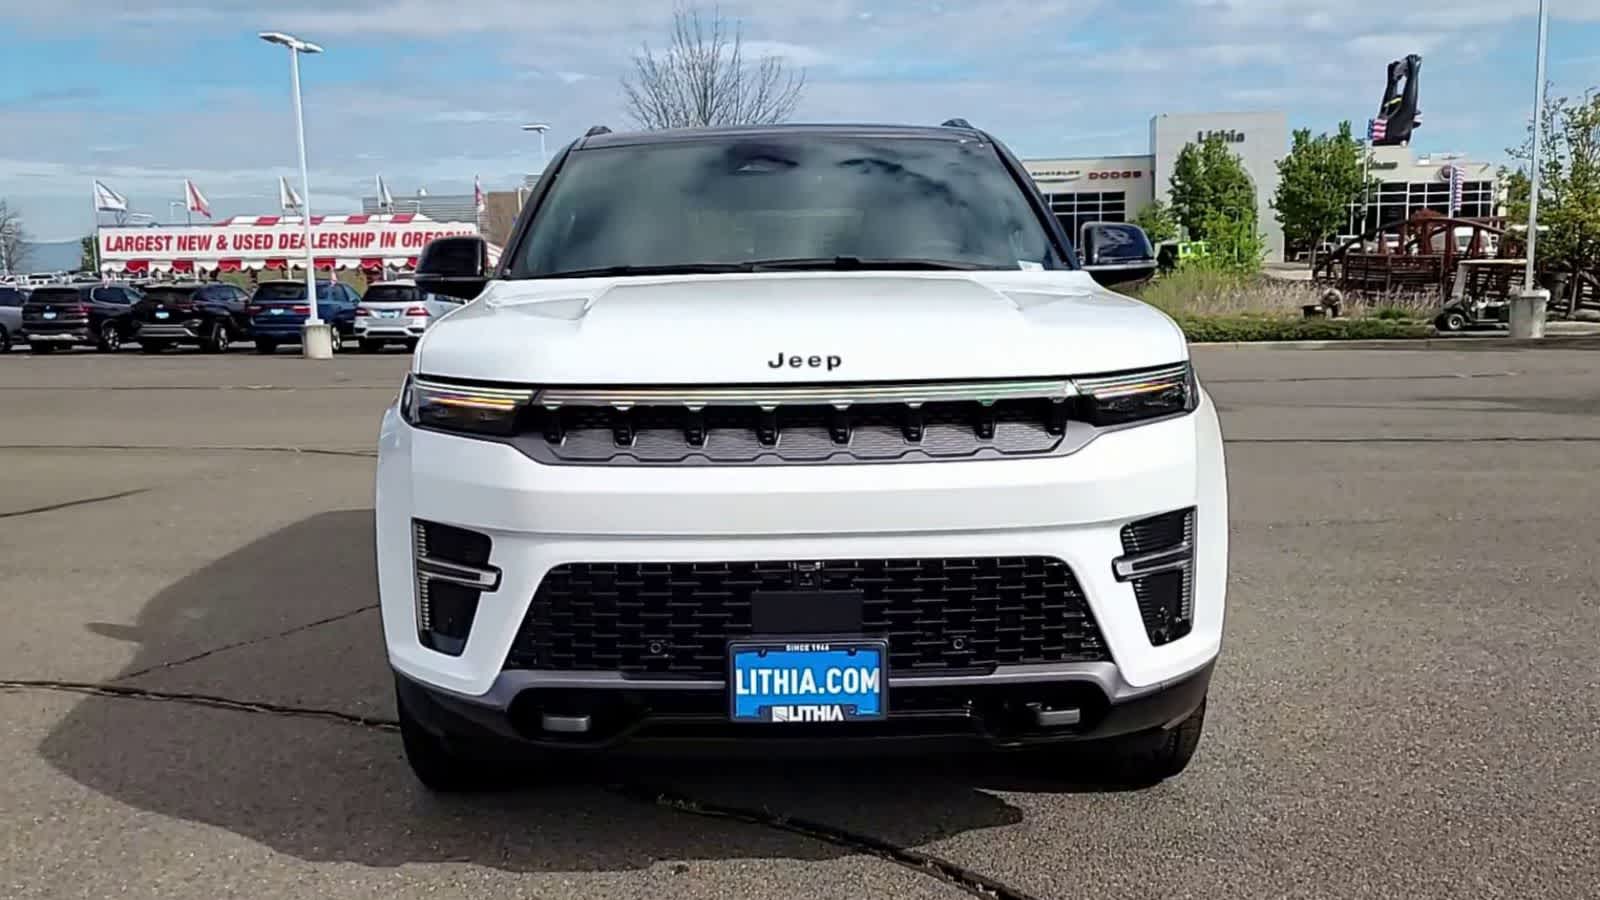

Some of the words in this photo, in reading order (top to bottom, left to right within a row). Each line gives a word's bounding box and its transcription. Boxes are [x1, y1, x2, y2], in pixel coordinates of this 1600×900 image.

[1088, 171, 1142, 180] DODGE
[105, 235, 172, 252] LARGEST
[176, 235, 212, 252] NEW
[216, 235, 228, 251] &
[232, 234, 273, 251] USED
[278, 232, 375, 249] DEALERSHIP
[380, 231, 397, 248] IN
[401, 230, 472, 248] ORE
[767, 352, 842, 371] Jeep
[786, 643, 809, 652] SINCE
[735, 667, 880, 695] LITHIA.COM
[788, 705, 844, 722] LITHIA
